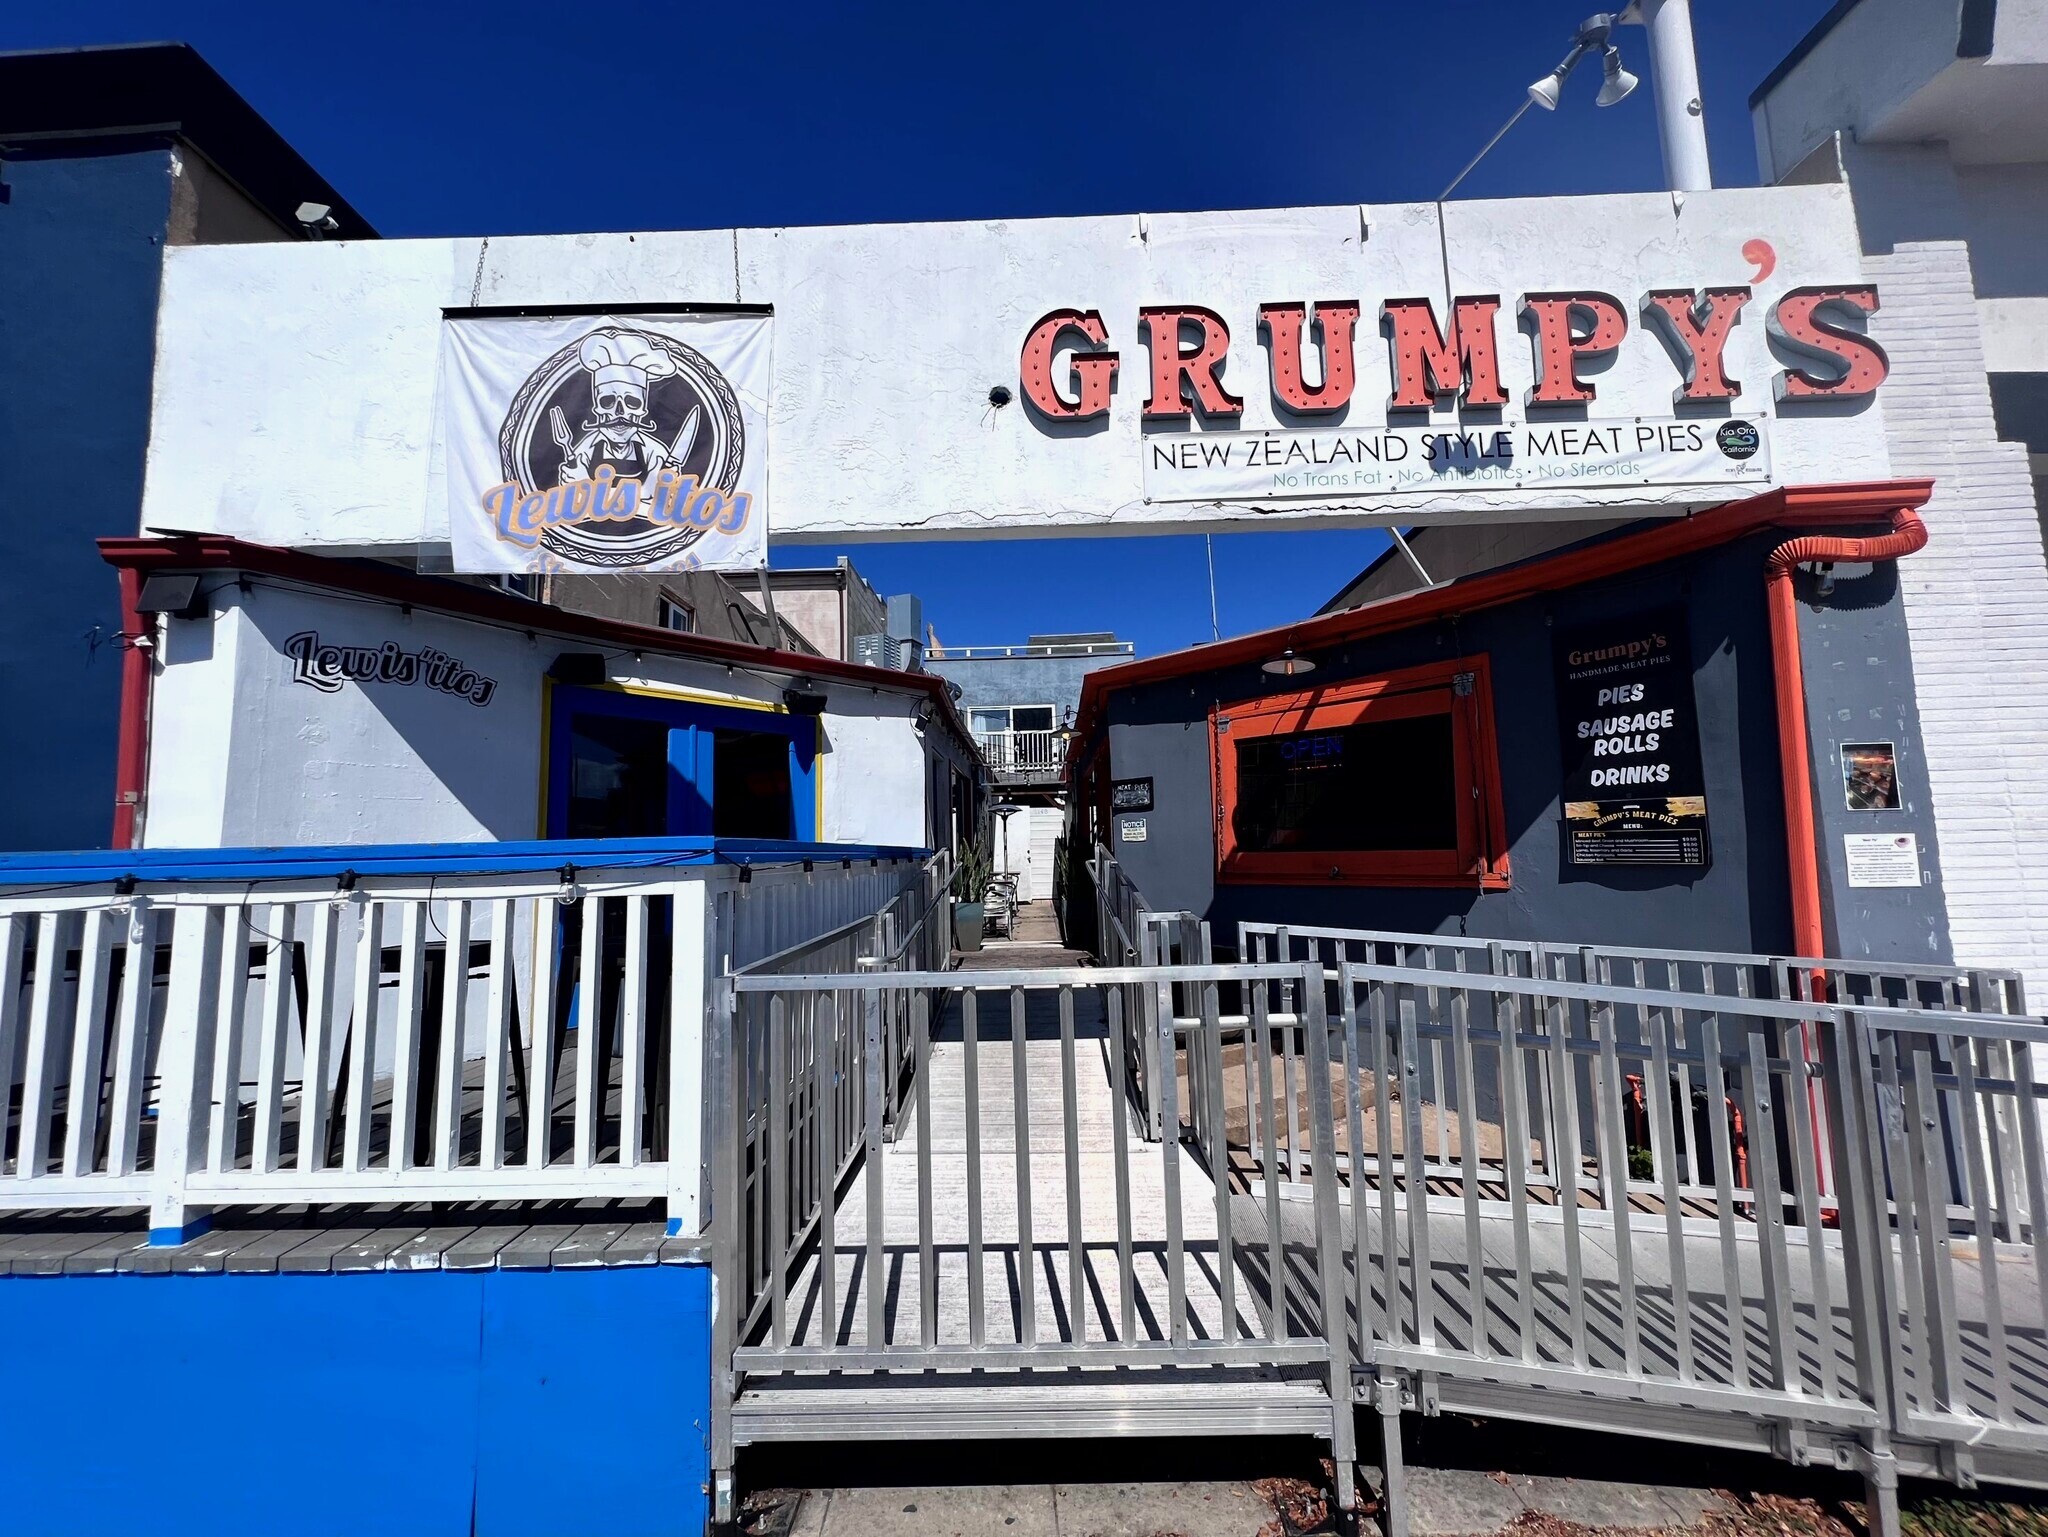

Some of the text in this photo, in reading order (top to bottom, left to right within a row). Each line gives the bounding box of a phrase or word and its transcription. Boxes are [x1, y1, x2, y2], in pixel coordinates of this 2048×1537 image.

[1020, 239, 1890, 423] GRUMPY'S
[1720, 427, 1735, 436] Kia
[1153, 424, 1704, 470] NEW ZEALAND STYLE MEAT PIES
[1273, 460, 1640, 488] No Trans Fat No Antibiotics No Steroids
[483, 463, 641, 549] Lewis
[1568, 633, 1667, 666] Grumpy's
[1569, 655, 1671, 680] HANDMADE MEAT PIES
[1598, 683, 1645, 707] PIES
[1577, 708, 1674, 739] SAUSAGE
[1280, 736, 1344, 759] OPEN
[1594, 733, 1660, 757] ROLLS
[1590, 763, 1671, 787] DRINKS
[1593, 811, 1679, 827] GRUMPY'S MEAT PIES
